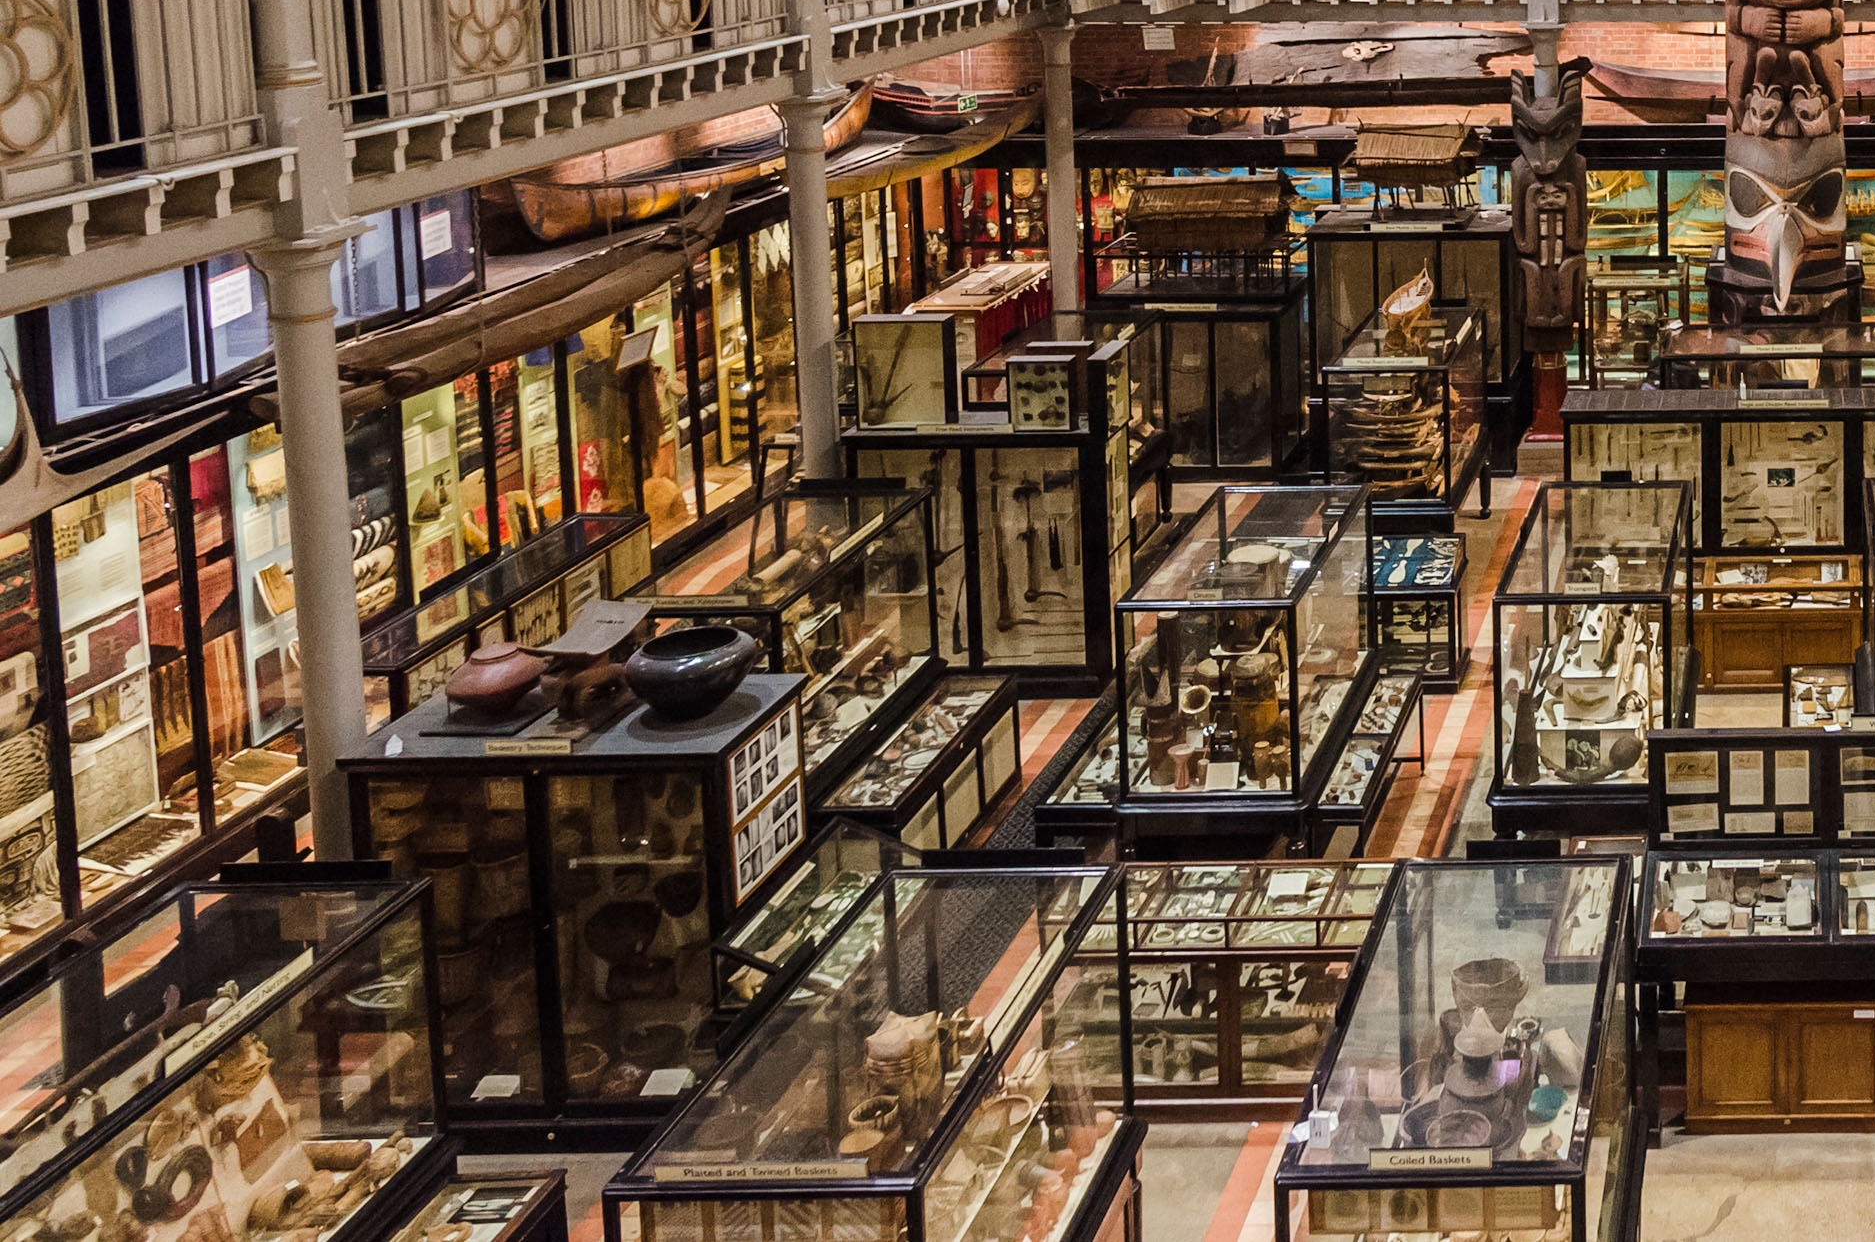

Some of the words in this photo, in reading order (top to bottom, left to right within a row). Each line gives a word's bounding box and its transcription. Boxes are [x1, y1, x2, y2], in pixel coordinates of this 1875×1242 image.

[1389, 1155, 1425, 1165] Coiled
[1429, 1154, 1471, 1165] Baskets
[683, 1168, 722, 1178] Plaited
[726, 1167, 746, 1177] and
[750, 1166, 791, 1177] Twined
[794, 1166, 838, 1176] Baskets
